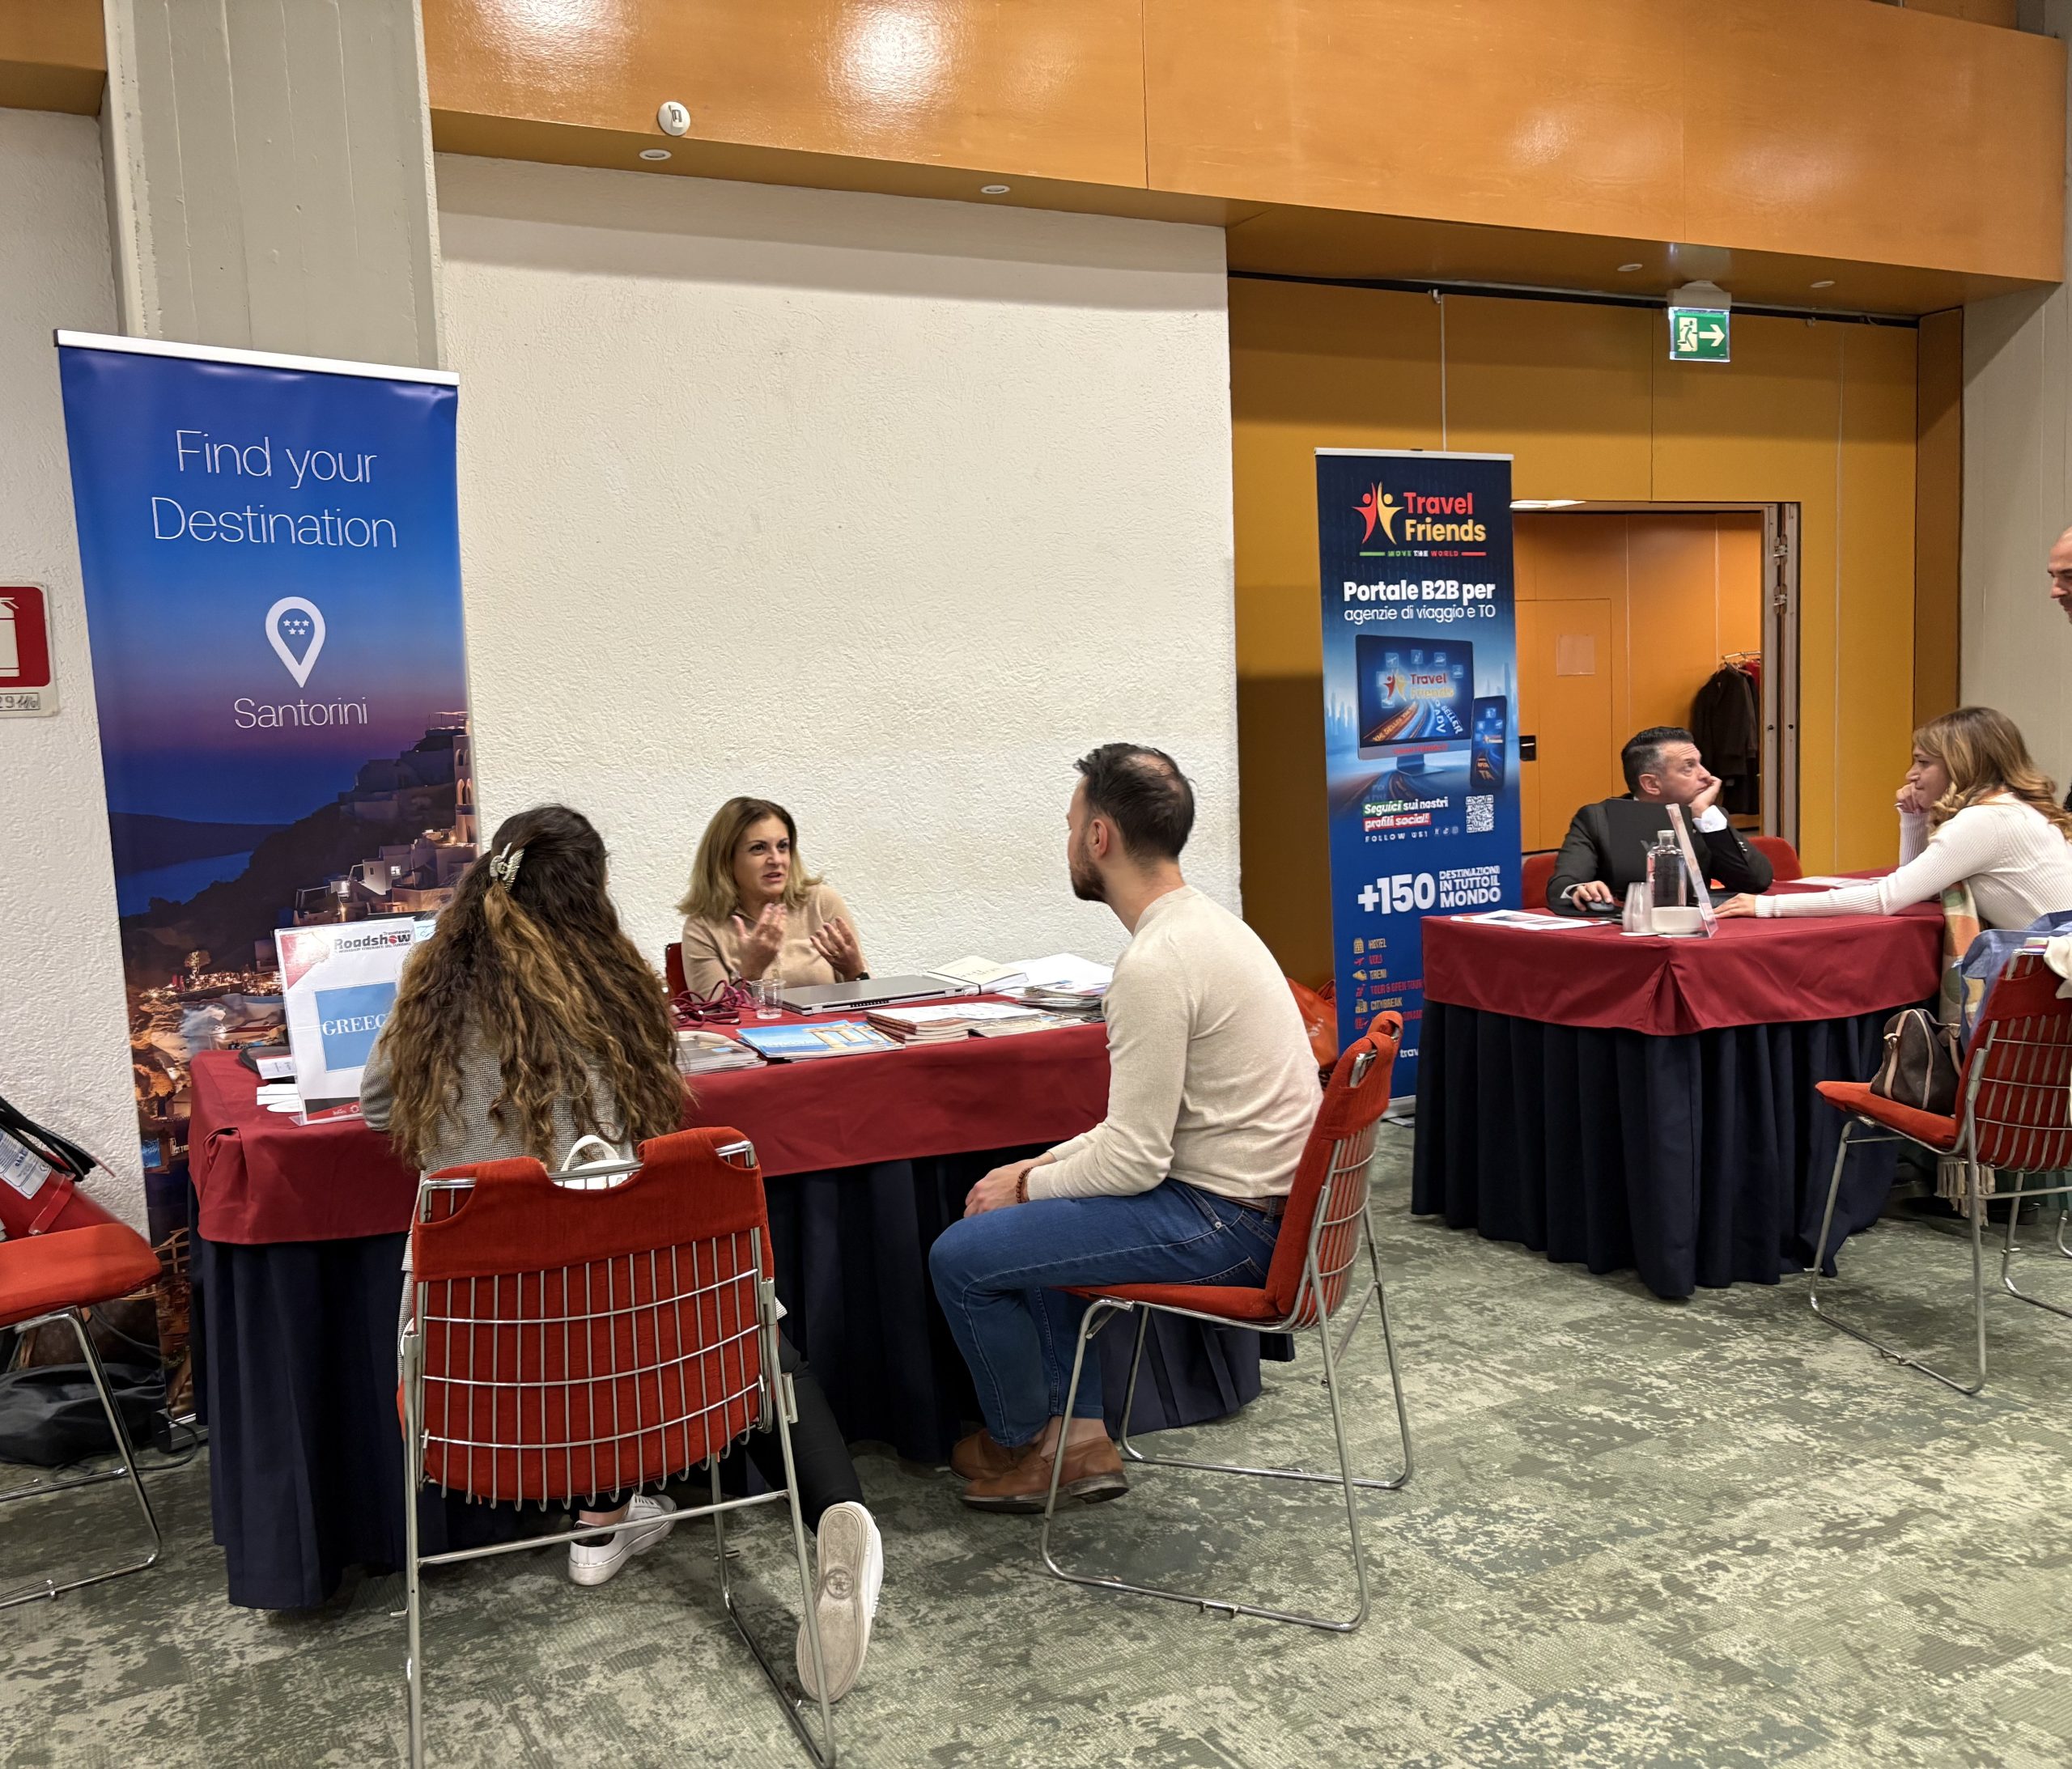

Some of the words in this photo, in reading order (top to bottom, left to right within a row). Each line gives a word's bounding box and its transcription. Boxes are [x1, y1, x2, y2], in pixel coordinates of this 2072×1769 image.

[176, 430, 272, 477] Find
[286, 448, 377, 489] your
[1403, 492, 1473, 515] Travel
[151, 496, 397, 549] Destination
[1405, 517, 1487, 542] Friends
[1344, 579, 1419, 602] Portale
[1421, 580, 1459, 600] B2B
[1463, 582, 1497, 605] per
[1344, 605, 1398, 625] agenzie
[1401, 605, 1415, 619] di
[1416, 605, 1464, 624] viaggio
[1467, 608, 1476, 619] e
[1478, 605, 1496, 618] TO
[1410, 673, 1447, 685] Travel
[234, 697, 368, 728] Santorini
[1441, 706, 1464, 735] SELLER
[1365, 800, 1403, 816] Seguici
[1403, 799, 1419, 811] sui
[1420, 796, 1449, 809] nostri
[1365, 816, 1395, 832] profili
[1365, 833, 1406, 842] FOLLOW
[1439, 866, 1501, 880] DESTINAZIONI
[1440, 880, 1454, 892] IN
[1454, 876, 1490, 889] TUTTO
[1490, 874, 1501, 886] IL
[1357, 872, 1436, 914] +150
[1440, 887, 1502, 908] MONDO
[334, 934, 411, 950] Roadshow
[322, 1013, 389, 1036] GREEC
